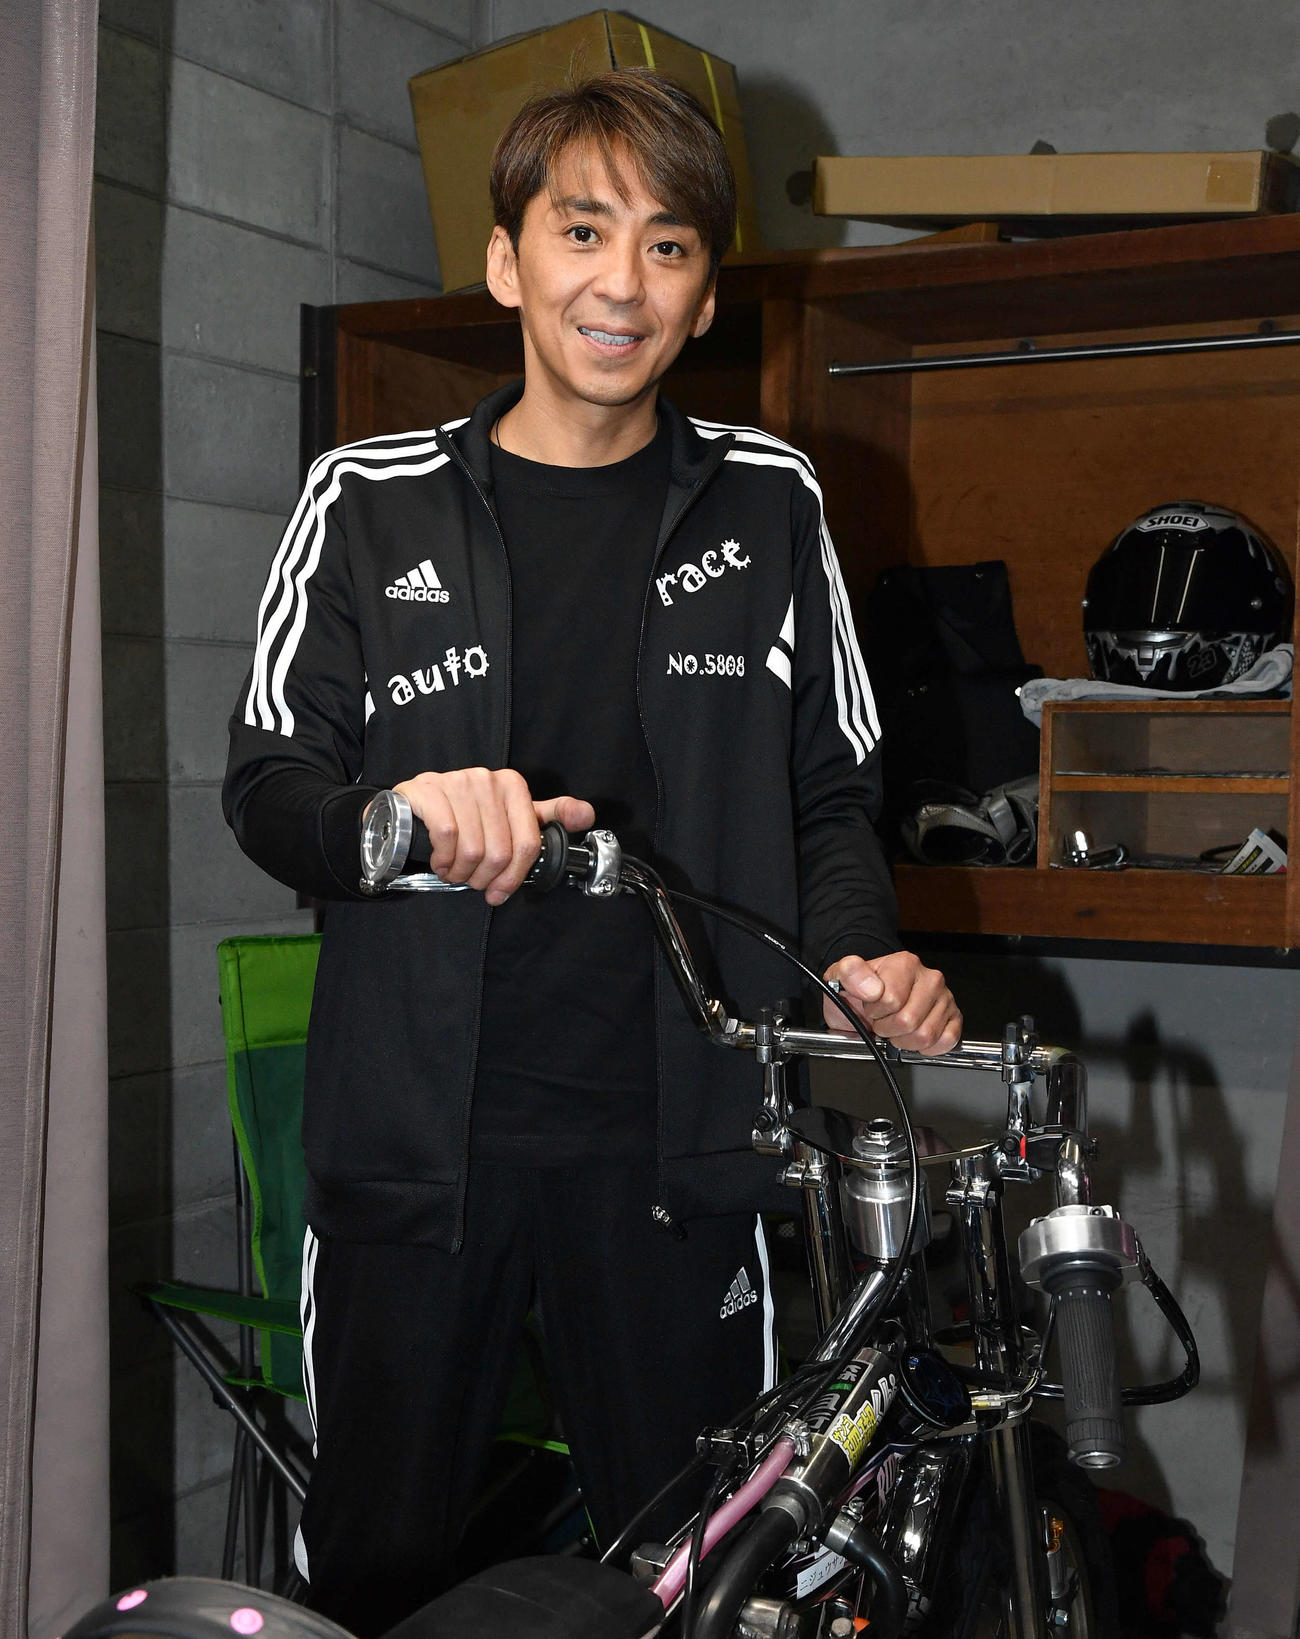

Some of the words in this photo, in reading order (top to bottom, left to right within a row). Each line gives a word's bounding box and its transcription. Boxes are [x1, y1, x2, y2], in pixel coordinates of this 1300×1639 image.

[1146, 514, 1200, 529] SHOEI
[655, 538, 752, 607] race
[385, 585, 450, 604] adidas
[387, 644, 490, 707] auto
[719, 1289, 758, 1320] adidas
